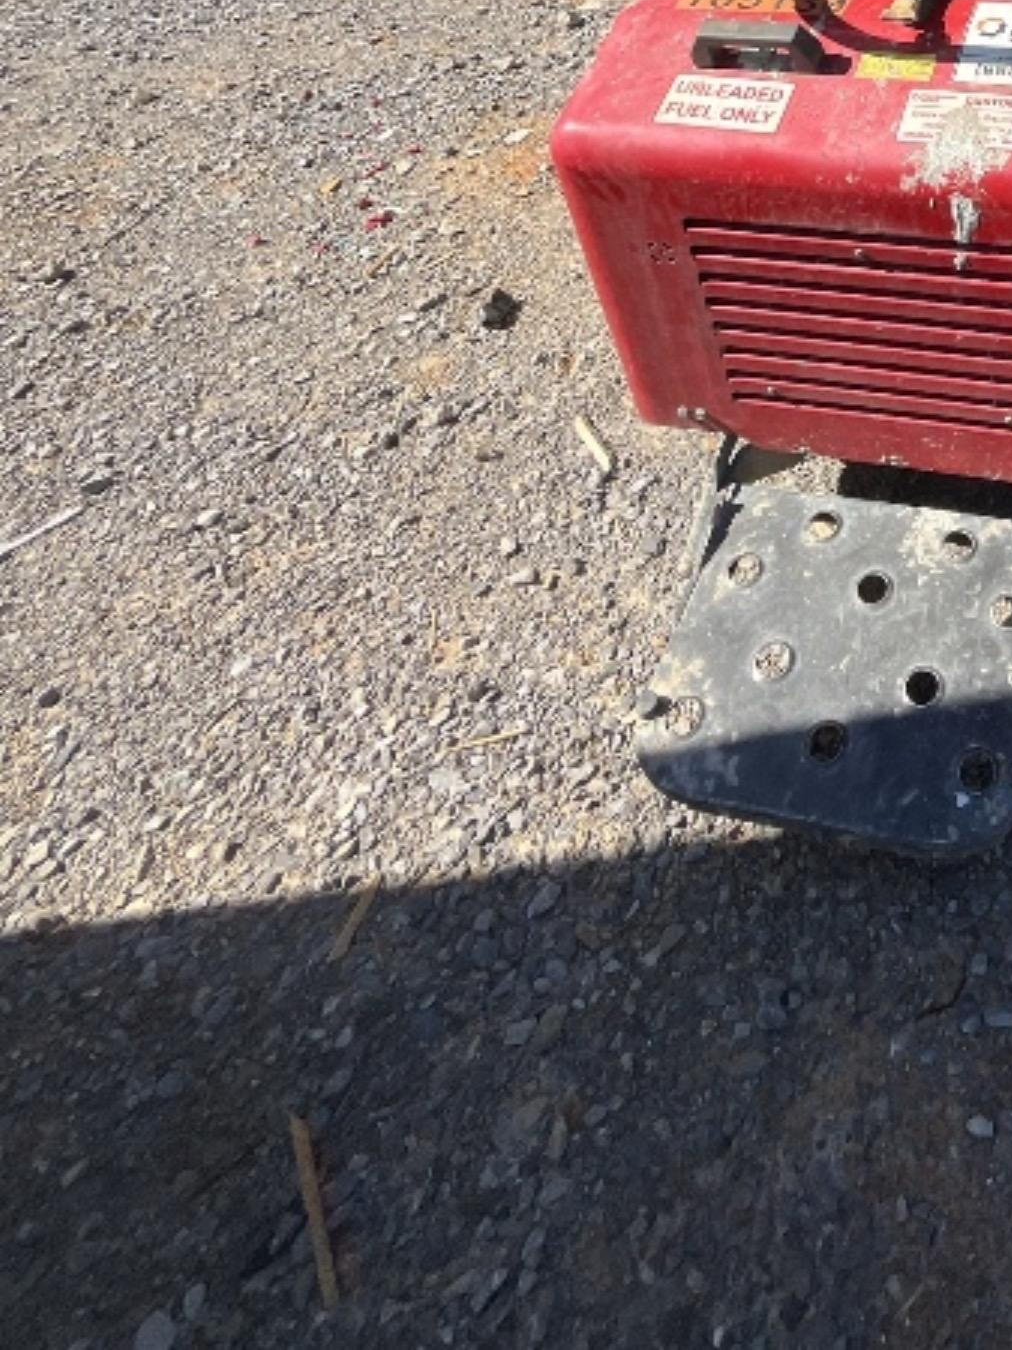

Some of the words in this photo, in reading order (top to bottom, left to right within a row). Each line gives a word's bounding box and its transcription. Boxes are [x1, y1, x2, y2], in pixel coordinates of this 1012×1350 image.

[674, 79, 785, 103] UNLEADED
[664, 101, 713, 119] FUEL
[719, 106, 777, 123] ONLY
